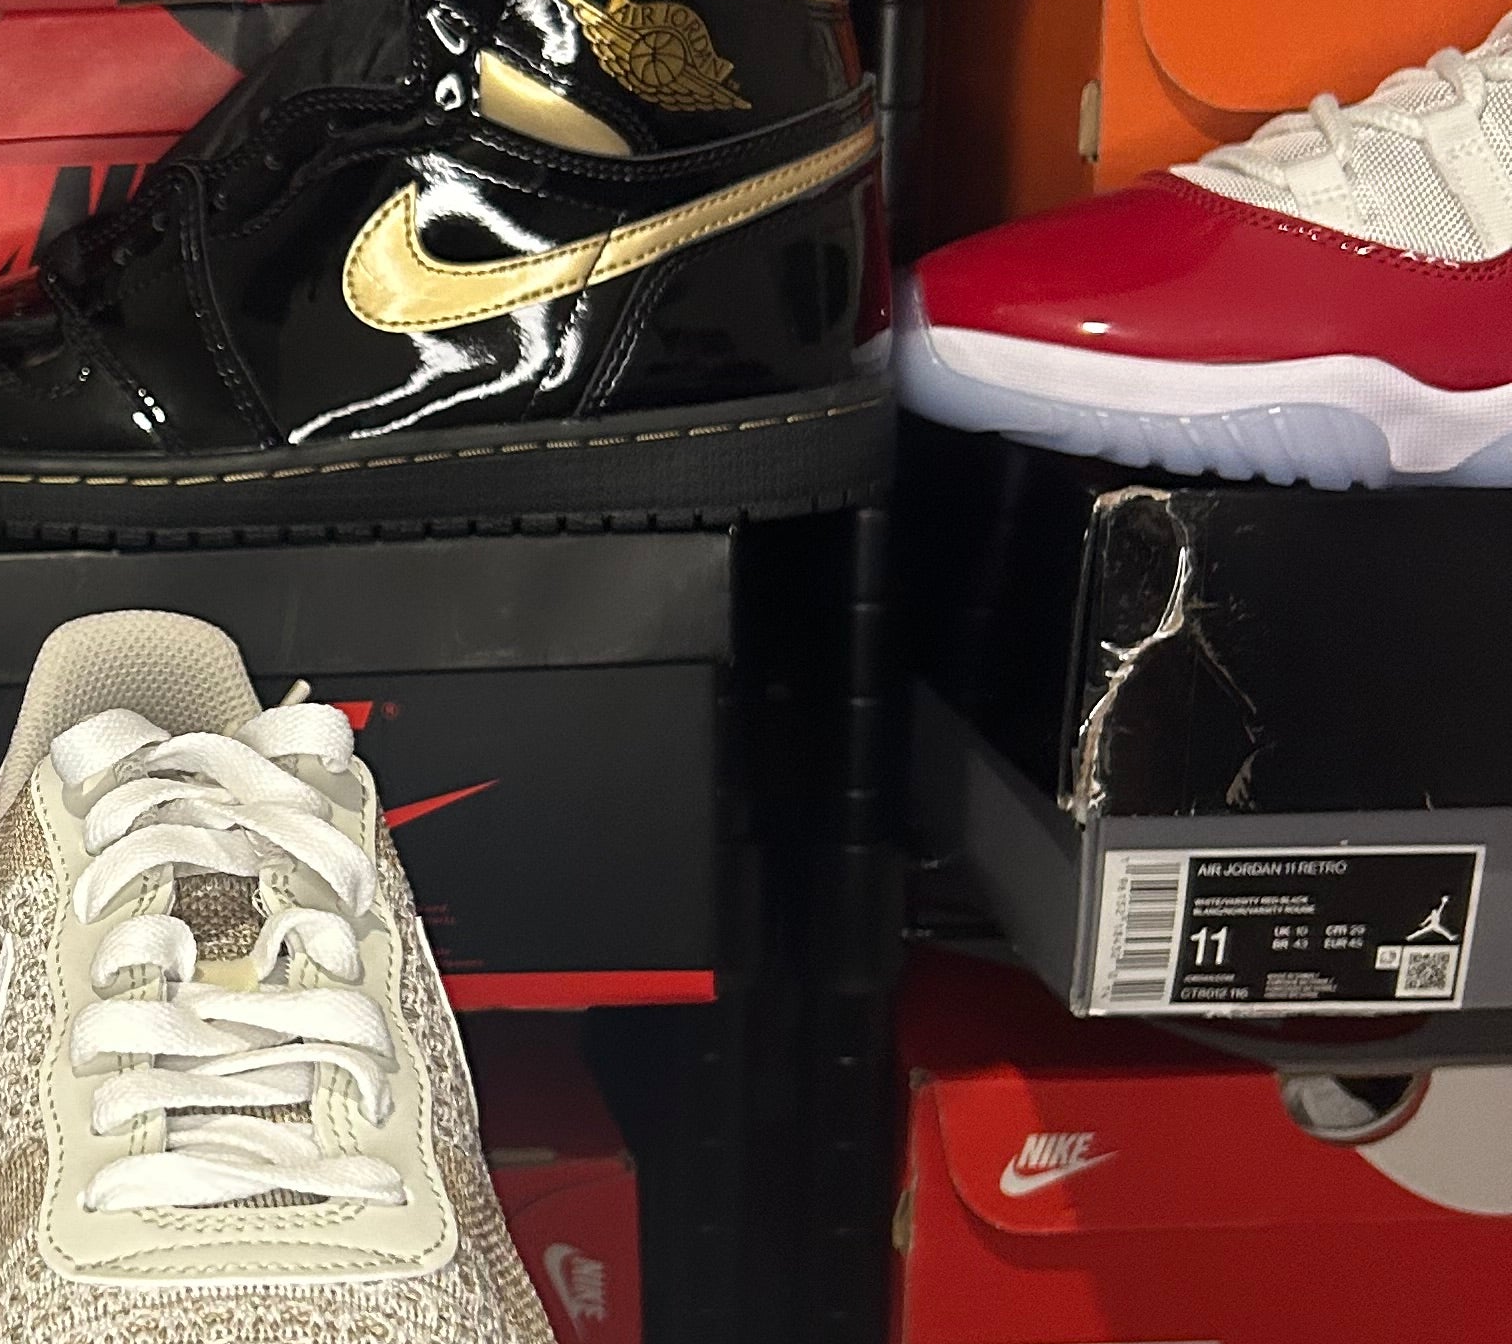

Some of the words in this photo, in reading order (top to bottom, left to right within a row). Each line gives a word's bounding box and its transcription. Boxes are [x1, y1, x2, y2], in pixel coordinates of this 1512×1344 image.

[1197, 861, 1222, 877] AIR
[1223, 860, 1283, 878] JORDAN
[1297, 859, 1349, 875] RETRO
[1189, 926, 1229, 967] 11
[1016, 1131, 1097, 1169] NIKE
